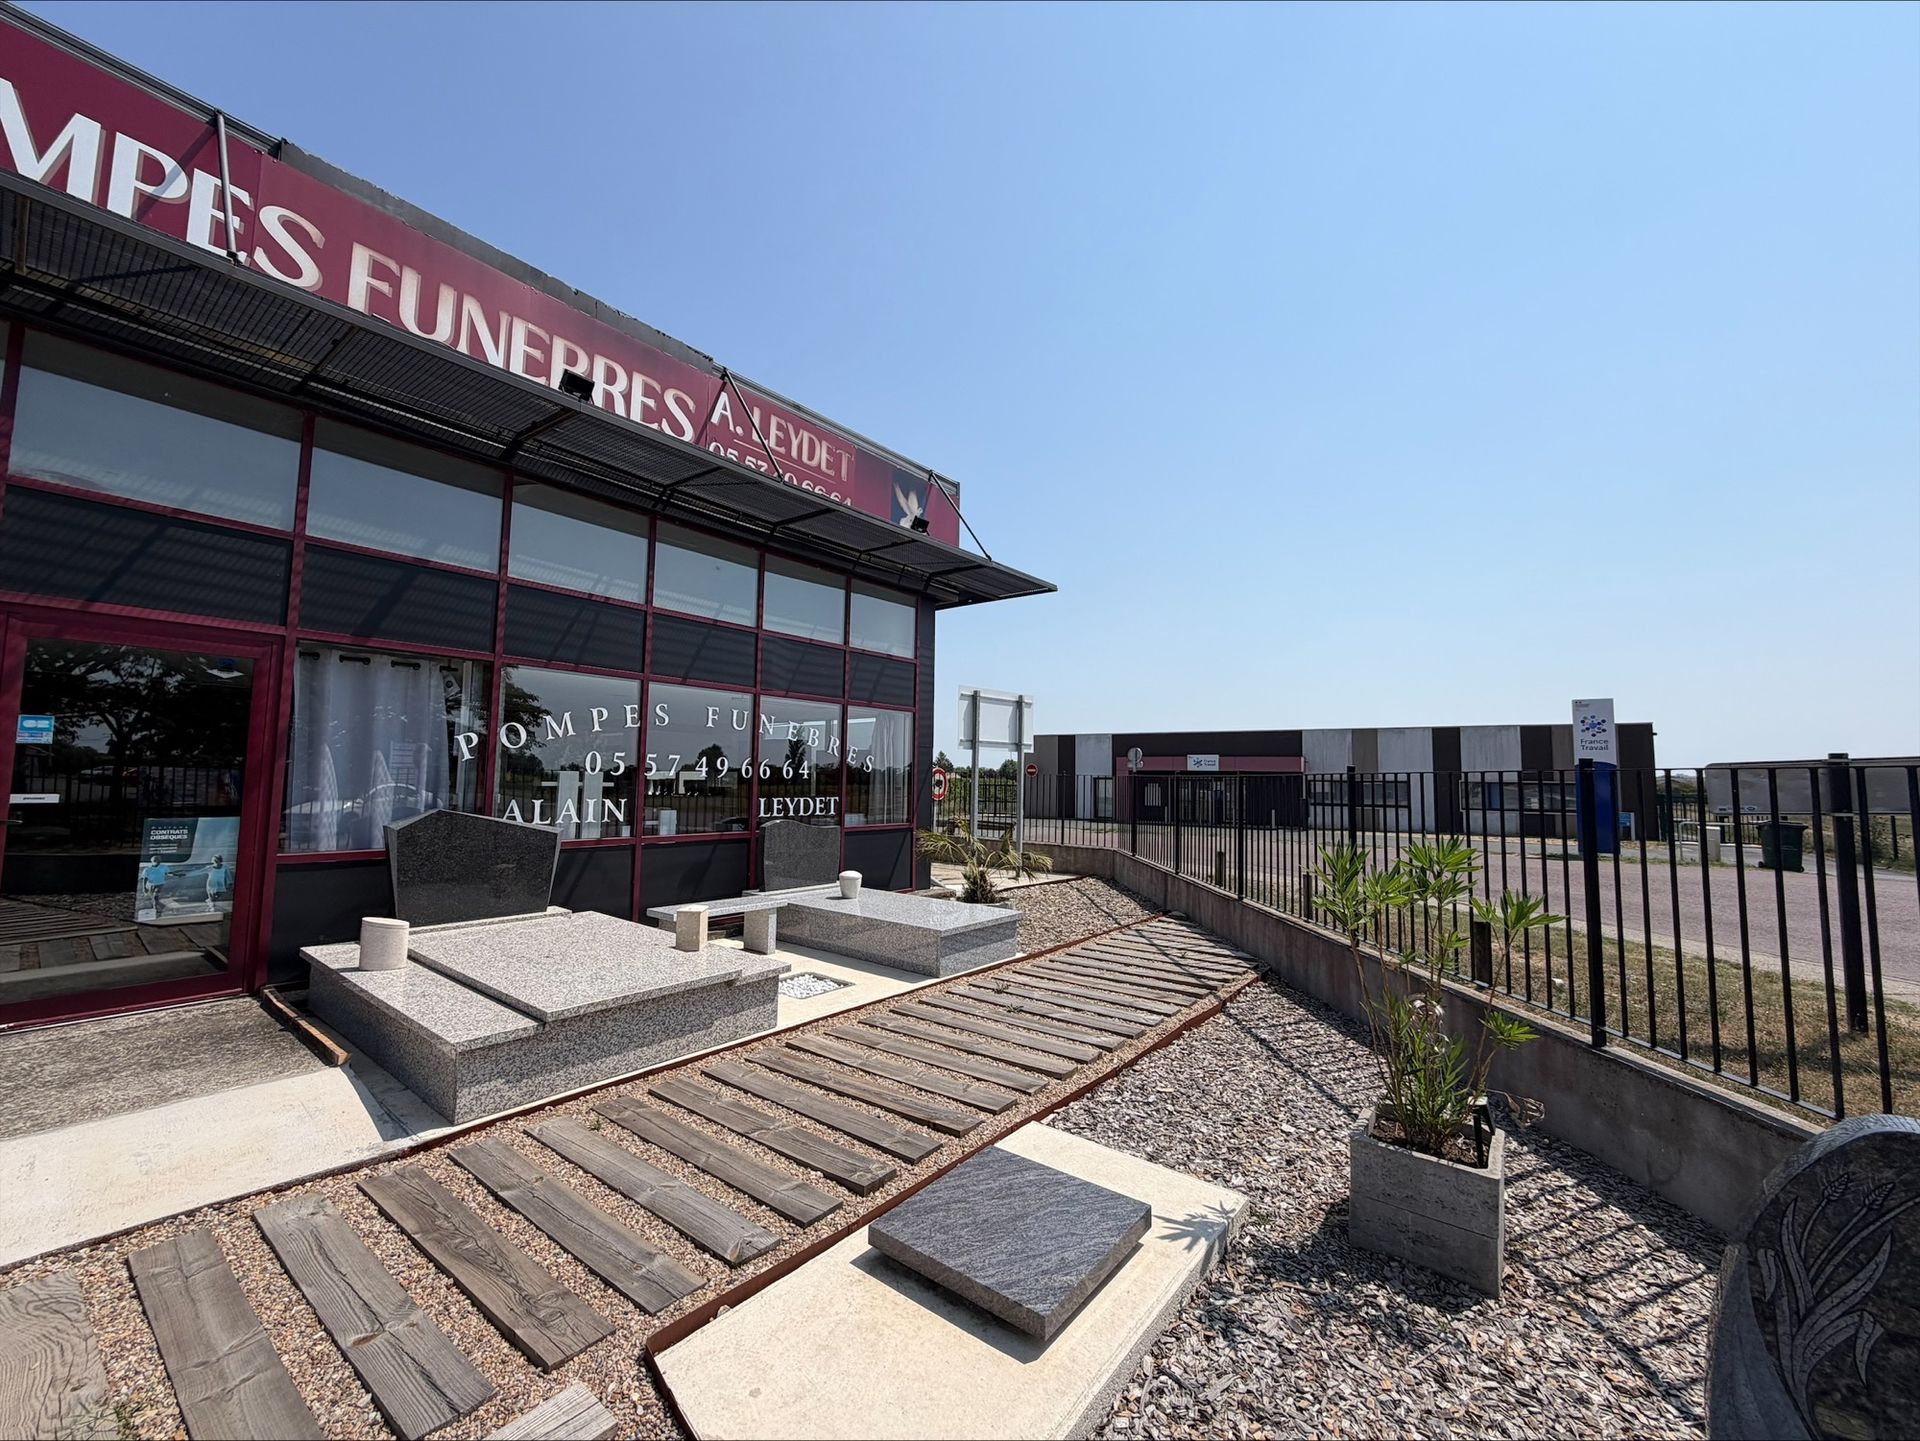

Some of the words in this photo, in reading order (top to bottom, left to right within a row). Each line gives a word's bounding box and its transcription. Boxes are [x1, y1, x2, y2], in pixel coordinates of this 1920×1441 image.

[711, 391, 744, 437] A.
[752, 406, 852, 482] LEYDET
[454, 703, 669, 762] POMPES
[706, 706, 874, 773] FUNEBRES
[585, 751, 626, 776] 05
[644, 753, 680, 777] 57
[695, 756, 729, 778] 49
[741, 757, 771, 780] 66
[782, 759, 809, 780] 64
[502, 798, 627, 825] ALAIN
[759, 796, 839, 818] LEYDET
